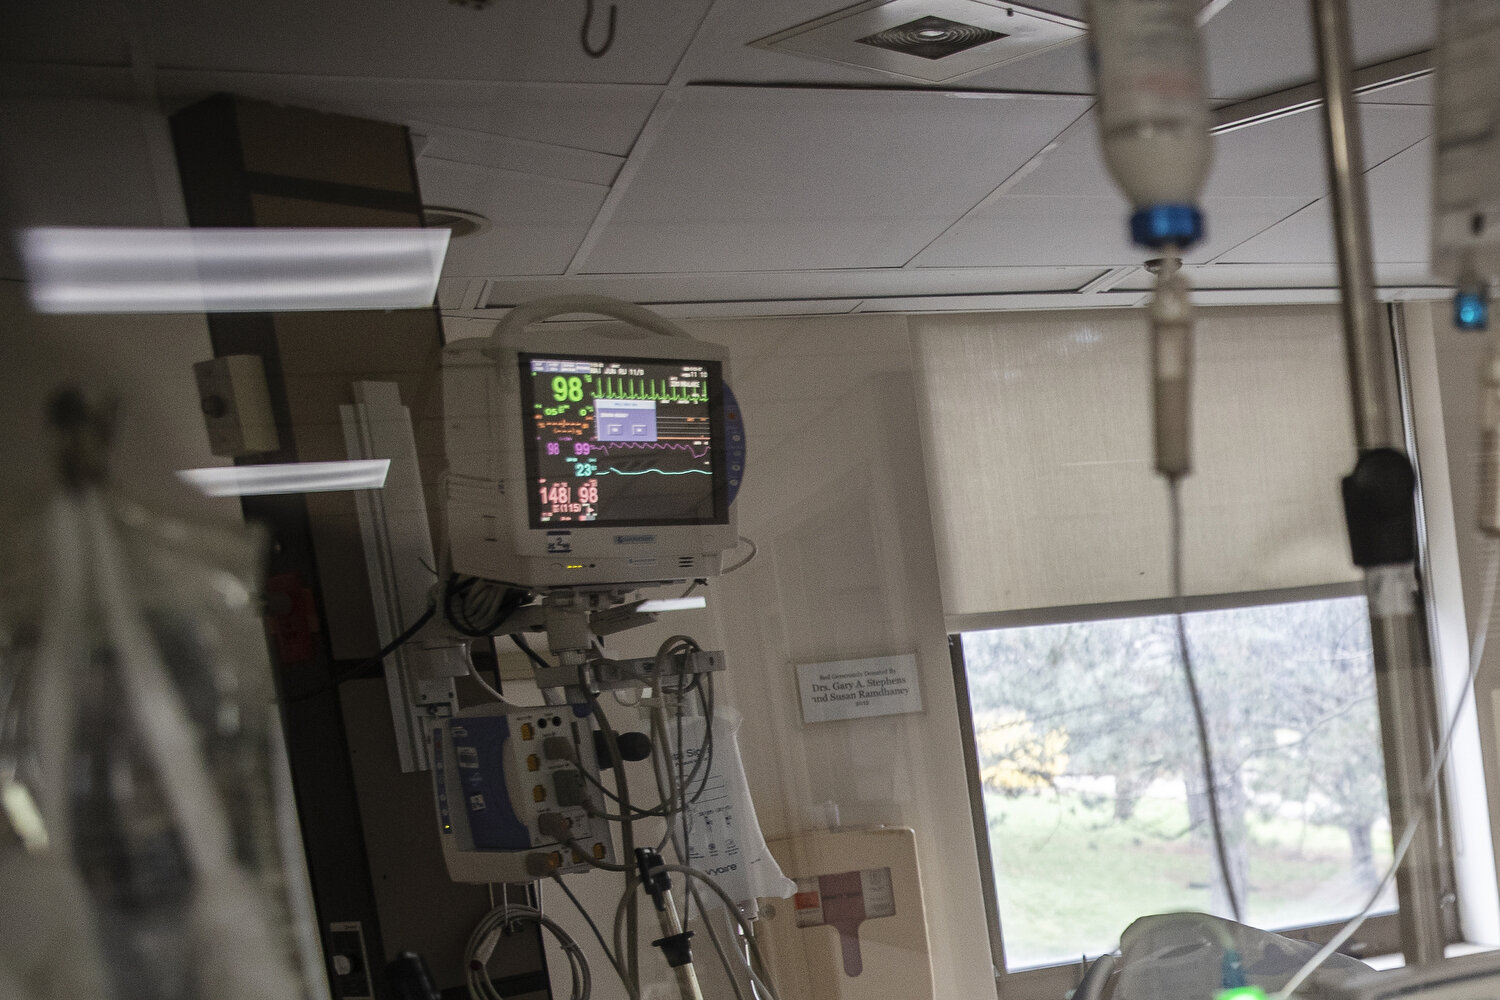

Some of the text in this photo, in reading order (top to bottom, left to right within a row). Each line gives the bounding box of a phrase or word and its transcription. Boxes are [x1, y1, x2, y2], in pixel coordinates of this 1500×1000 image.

[552, 376, 584, 402] 98
[547, 443, 560, 455] 98
[574, 443, 591, 455] 99
[575, 463, 592, 477] 23
[578, 487, 599, 503] 98
[812, 676, 907, 692] Drs. Gary A. Stephens
[830, 692, 856, 701] Susan
[858, 687, 910, 699] Ramdhaney
[705, 862, 737, 877] vyaire
